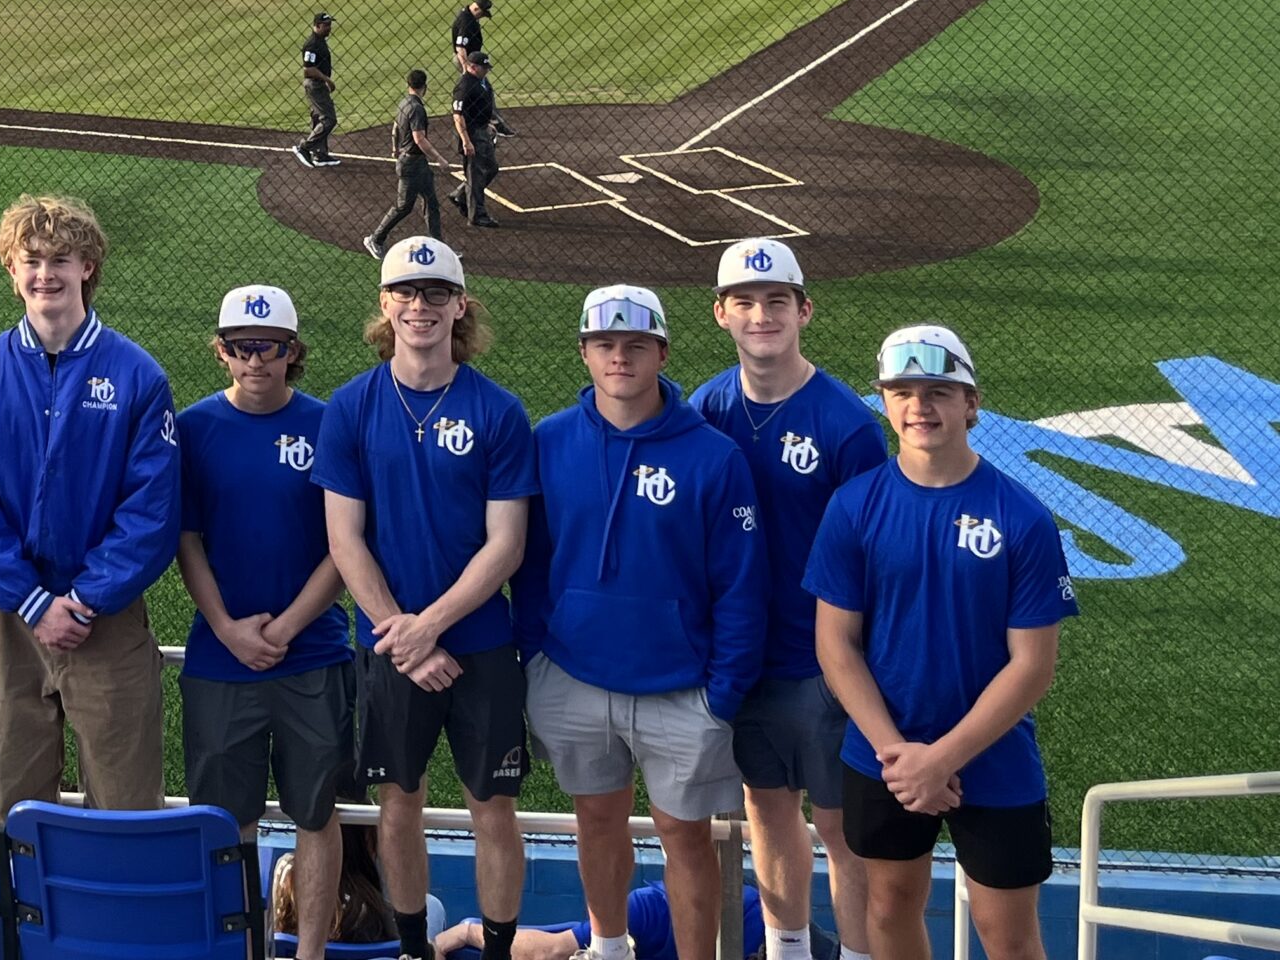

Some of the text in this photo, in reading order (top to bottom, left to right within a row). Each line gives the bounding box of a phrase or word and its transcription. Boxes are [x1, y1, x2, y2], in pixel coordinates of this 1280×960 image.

[409, 243, 436, 266] HC
[744, 248, 773, 272] HC
[244, 295, 271, 319] HC
[82, 401, 118, 411] CHAMPION
[90, 376, 116, 403] HC
[160, 409, 177, 447] 32
[436, 416, 475, 456] HC
[279, 434, 314, 471] HC
[782, 432, 820, 475] HC
[636, 464, 677, 506] HC
[958, 513, 1002, 559] HC
